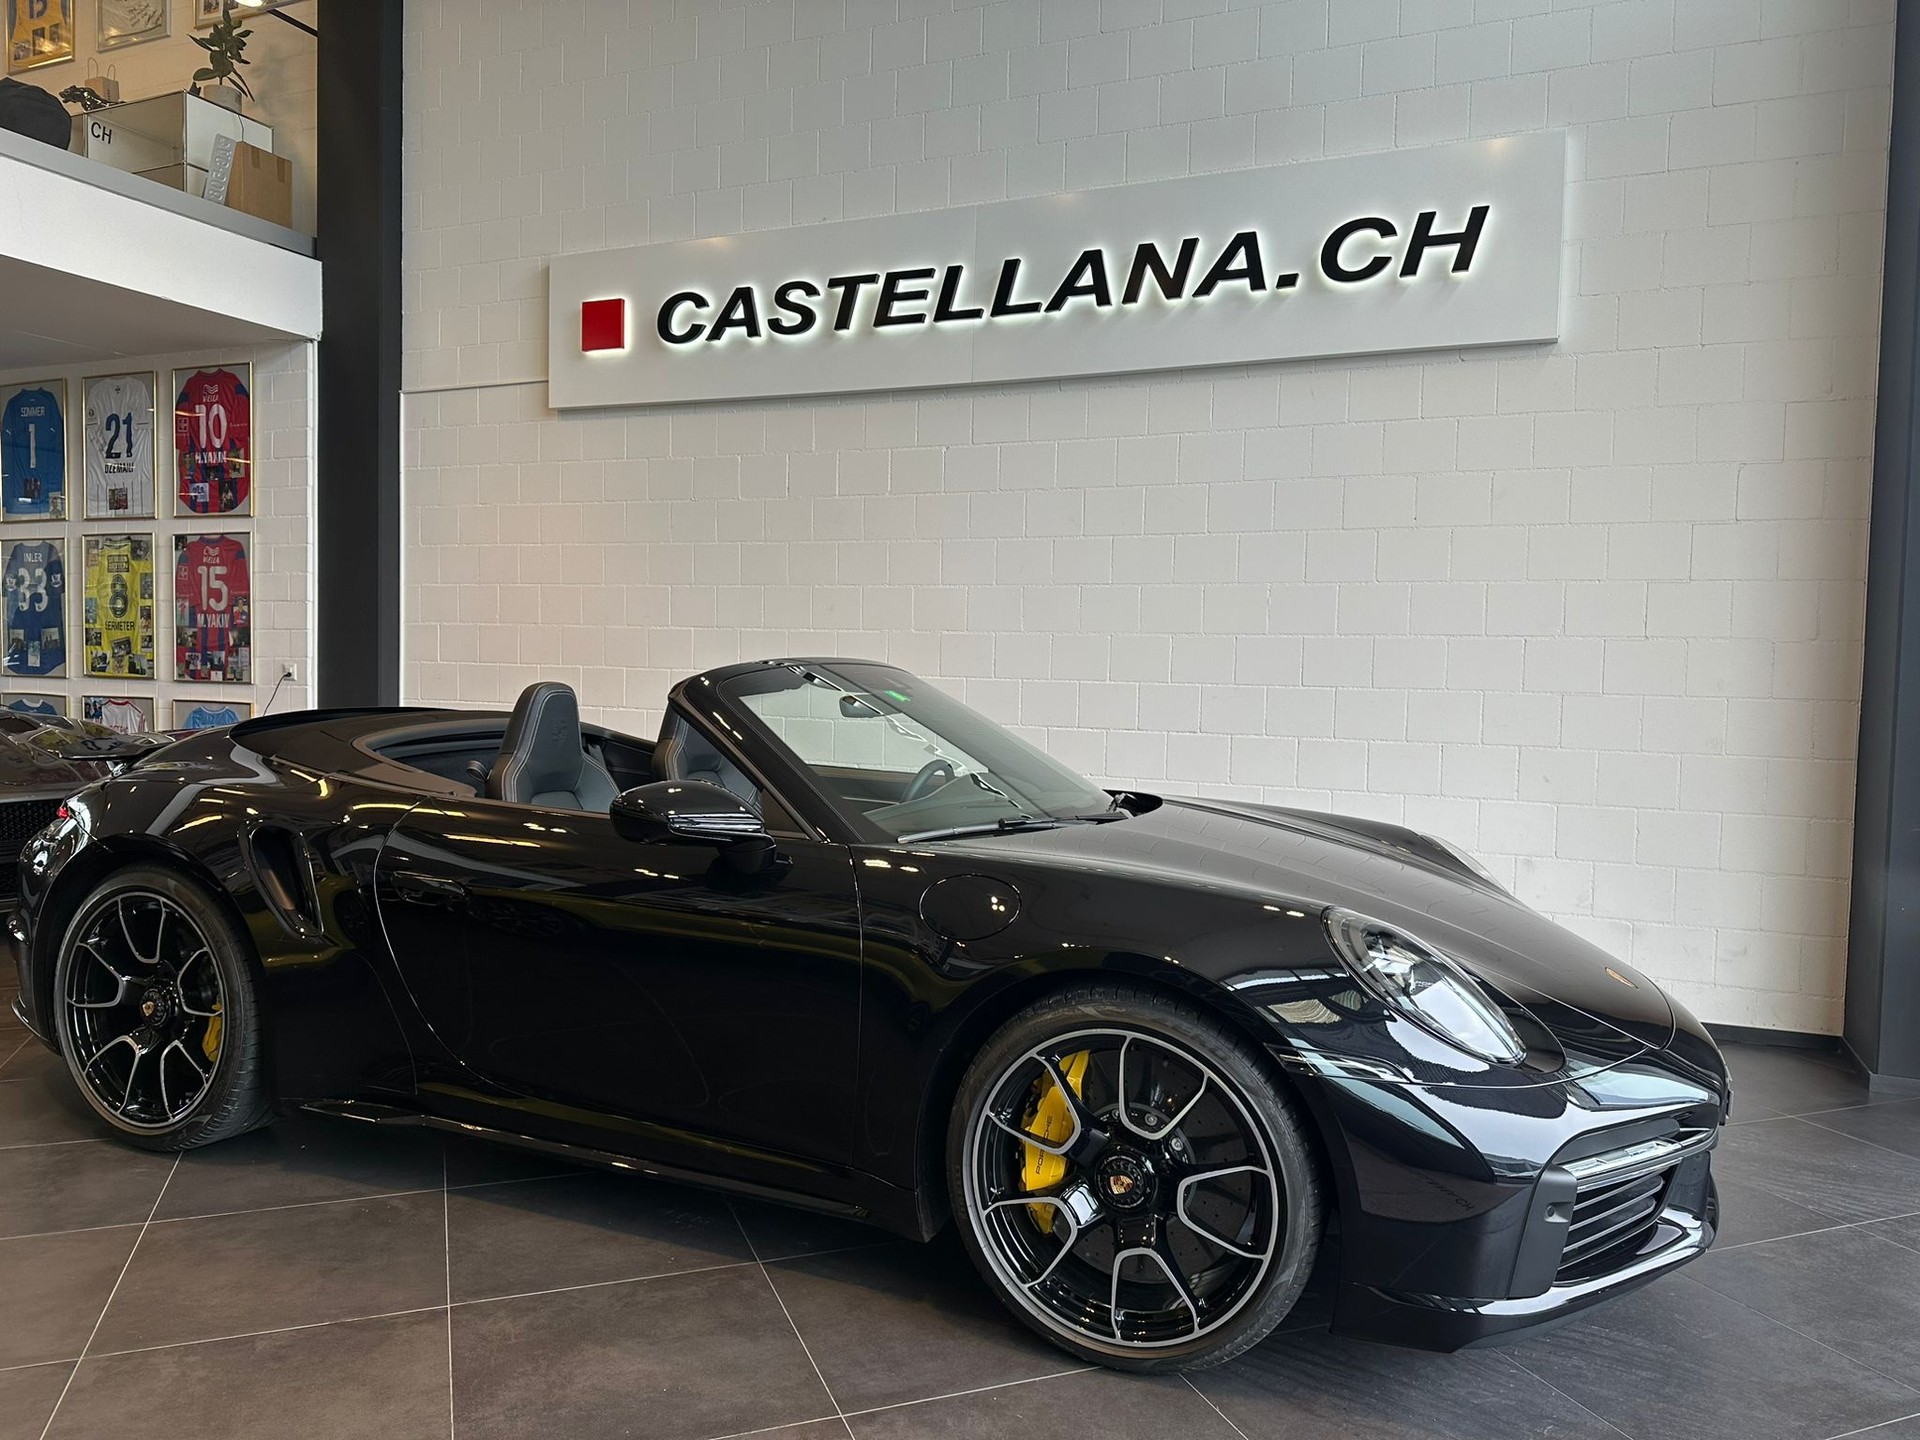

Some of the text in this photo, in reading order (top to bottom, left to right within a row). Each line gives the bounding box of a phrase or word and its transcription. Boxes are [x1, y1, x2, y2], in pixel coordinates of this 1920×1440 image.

[91, 121, 112, 144] CH
[656, 205, 1490, 345] CASTELLANA.CH
[28, 423, 37, 469] 1
[105, 412, 133, 459] 21
[195, 403, 228, 449] 10
[23, 552, 43, 563] INLER
[18, 567, 49, 612] 33
[109, 573, 129, 619] 8
[197, 565, 229, 612] 15
[1035, 1115, 1053, 1175] PORCHE
